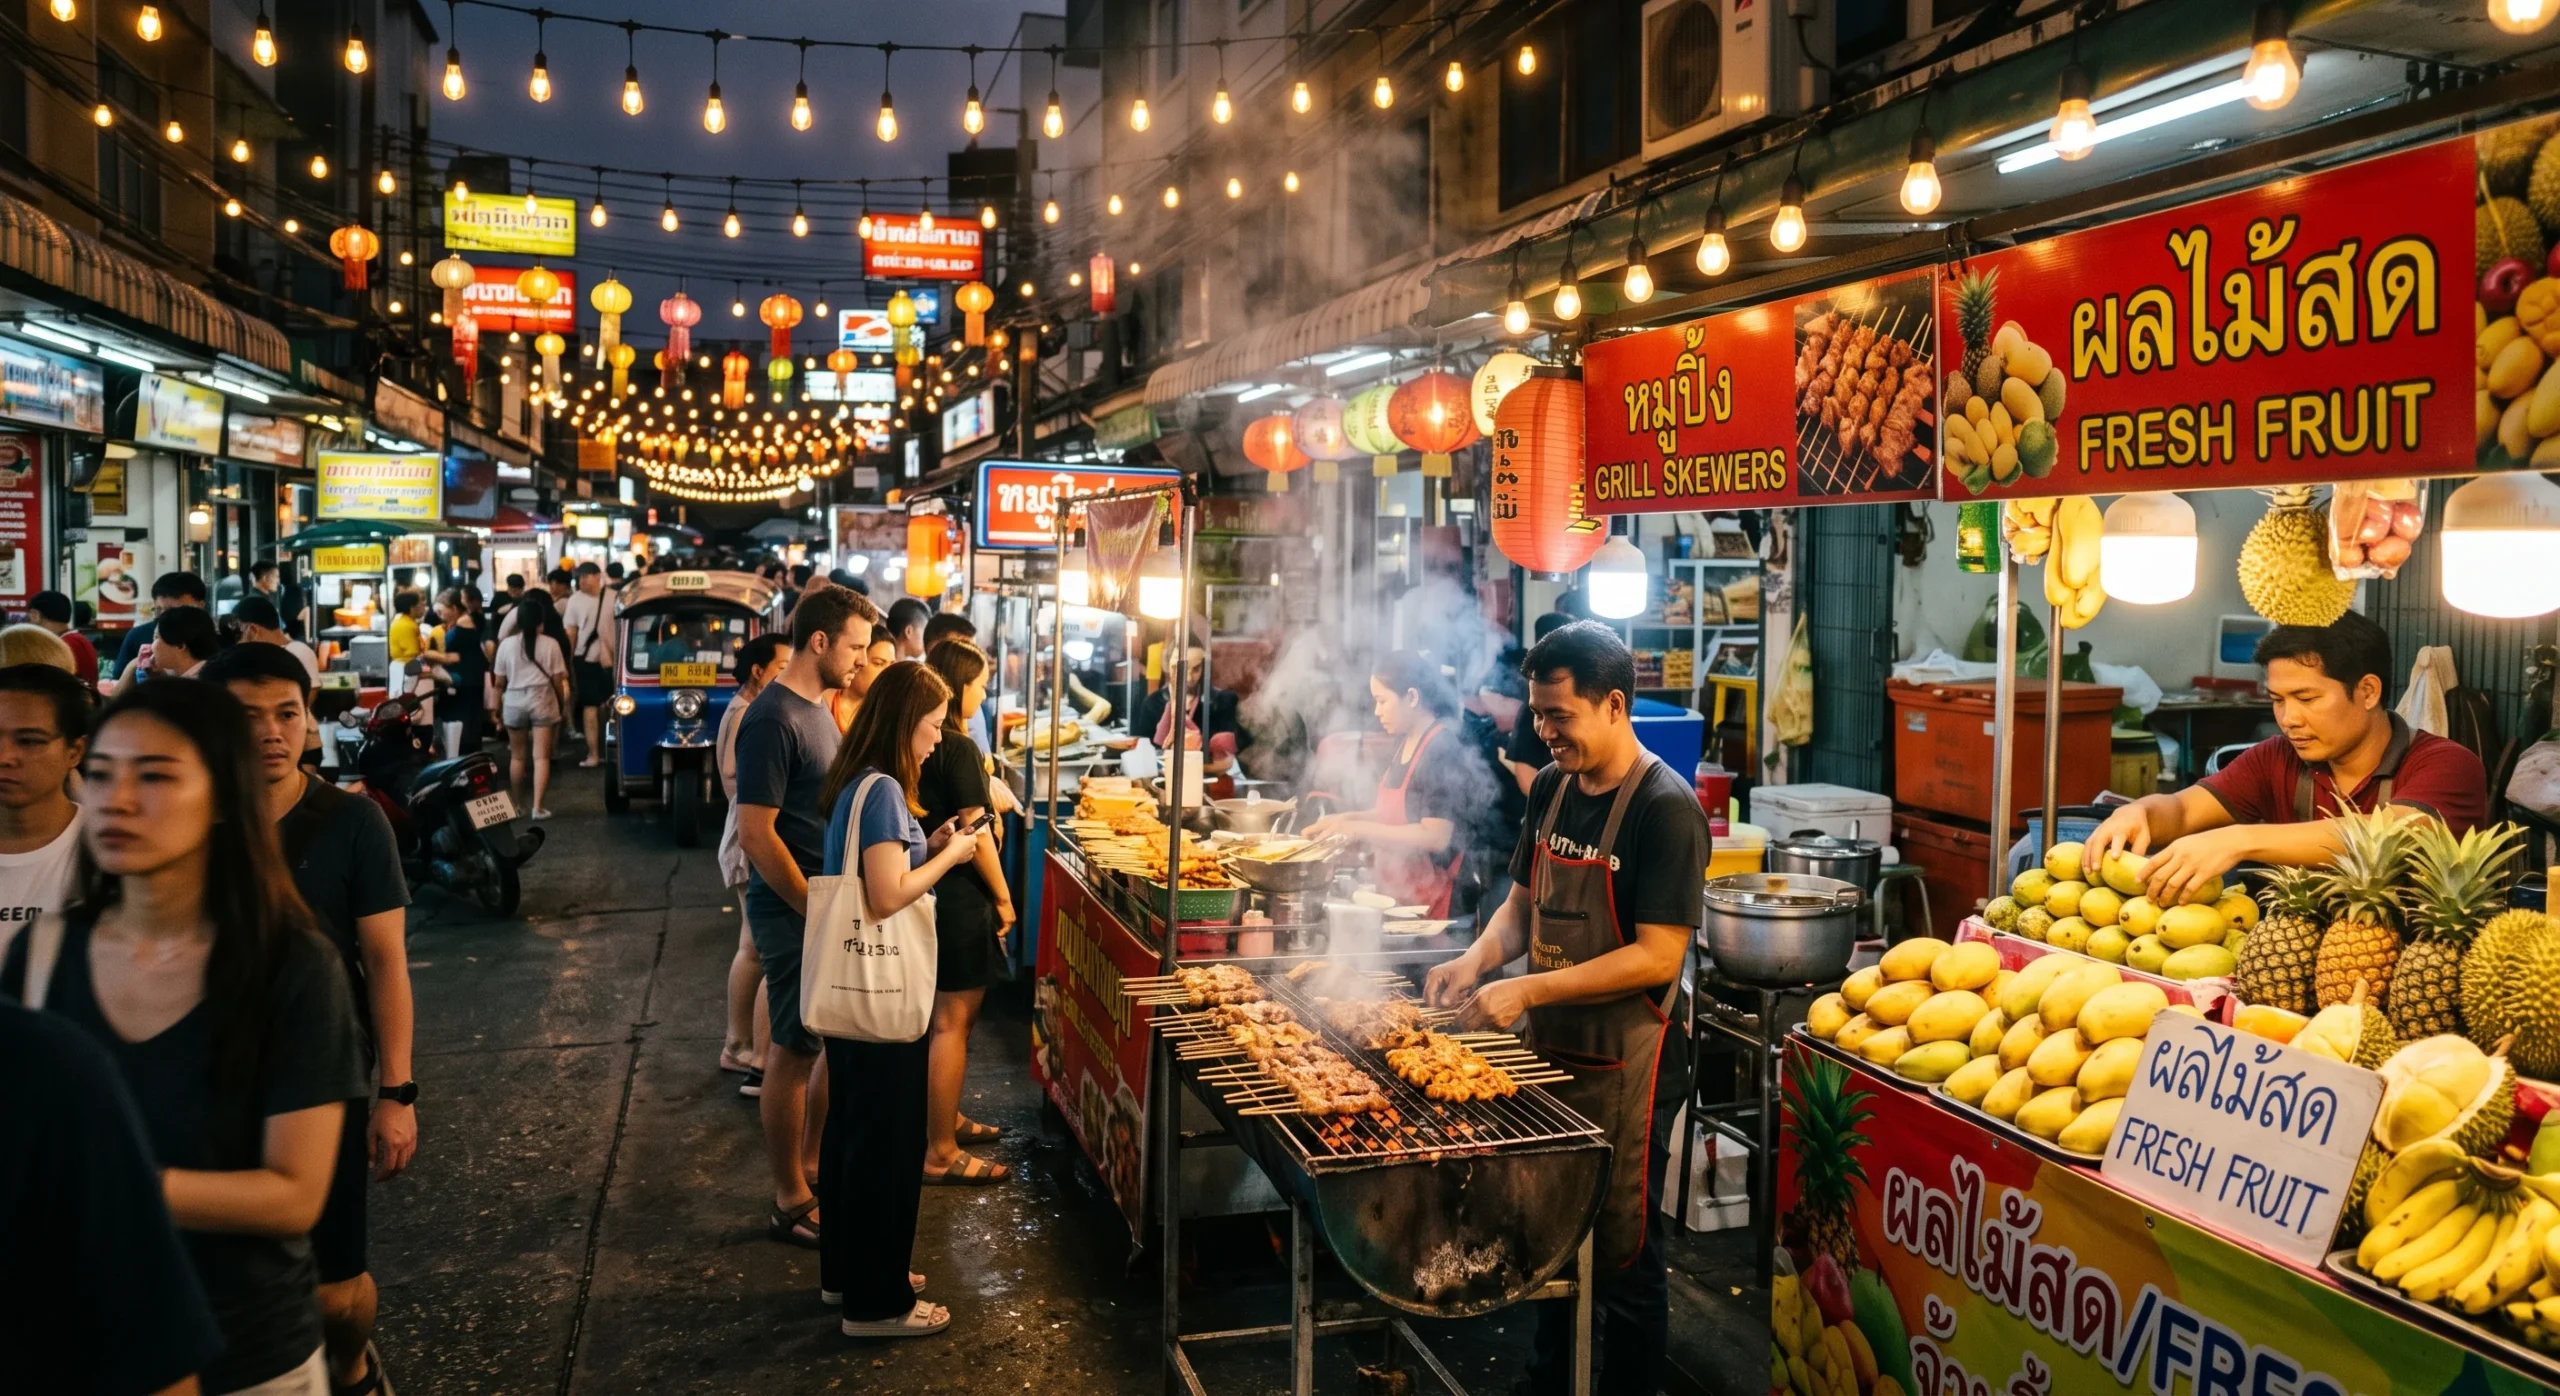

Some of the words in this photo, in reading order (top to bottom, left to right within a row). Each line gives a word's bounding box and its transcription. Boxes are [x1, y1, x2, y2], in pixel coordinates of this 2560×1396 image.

[2071, 216, 2439, 380] ผลไม้สด
[1623, 326, 1733, 455] หมูปิ้ง
[2079, 402, 2234, 473] FRESH
[2256, 380, 2434, 461] FRUIT
[1594, 464, 1656, 501] GRILL
[1662, 448, 1787, 498] SKEWERS
[2149, 1025, 2338, 1146] ผลไม้สด
[2115, 1116, 2216, 1193] FRESH
[2217, 1153, 2331, 1236] FRUIT
